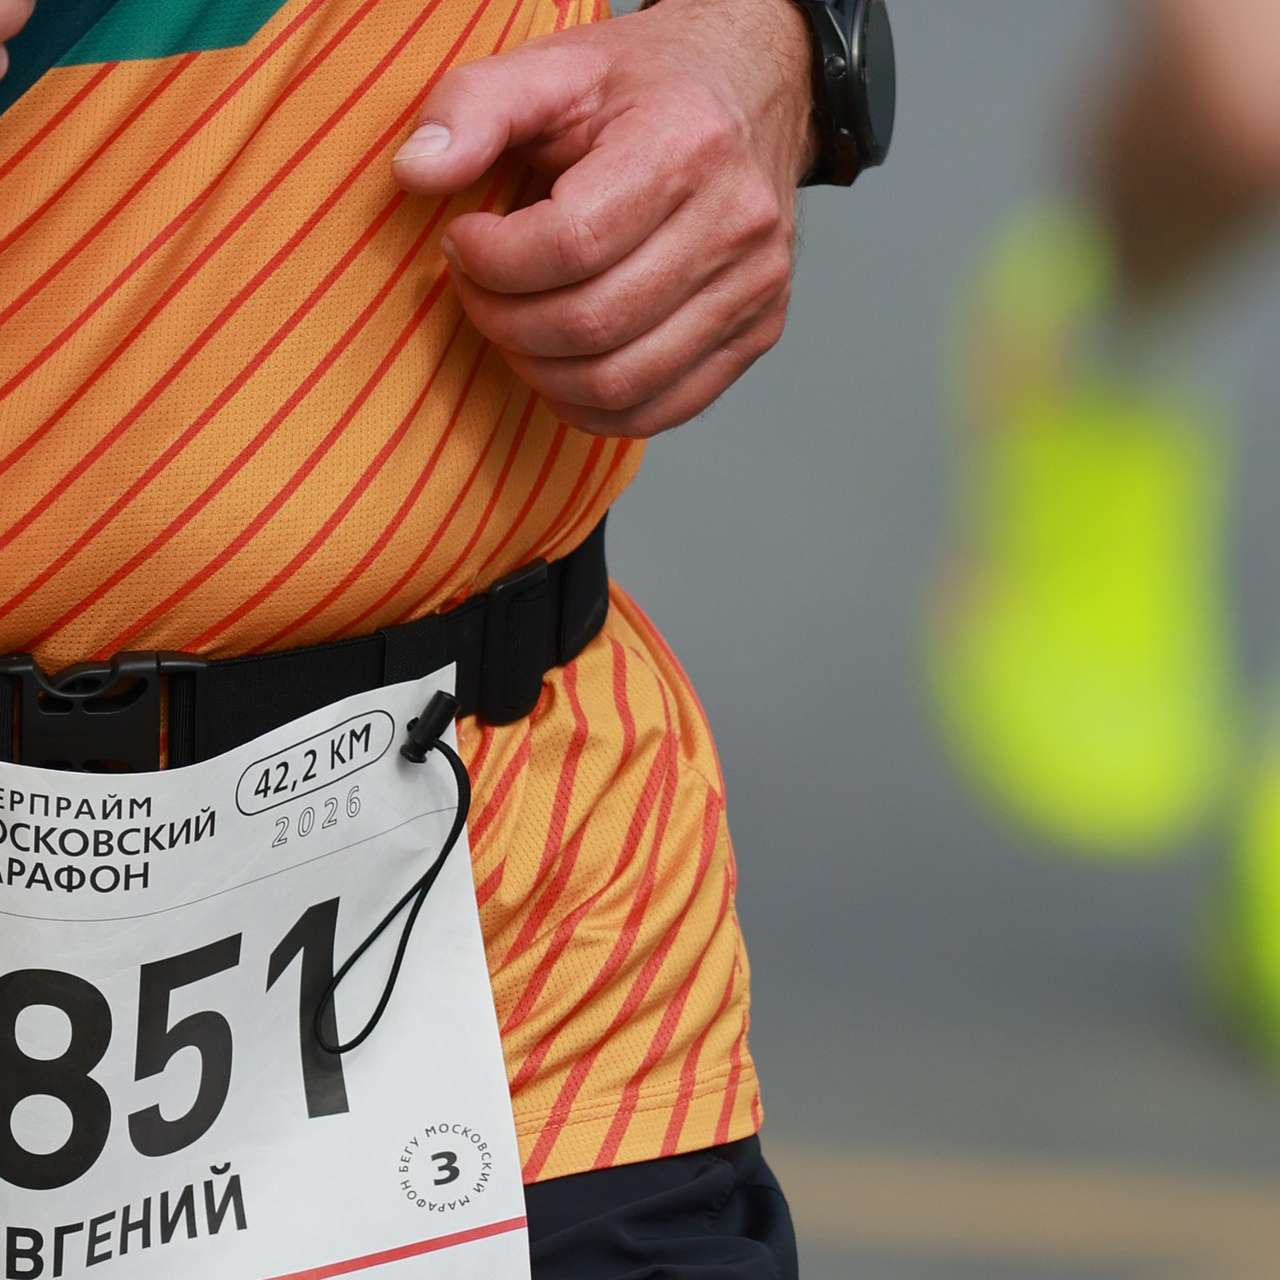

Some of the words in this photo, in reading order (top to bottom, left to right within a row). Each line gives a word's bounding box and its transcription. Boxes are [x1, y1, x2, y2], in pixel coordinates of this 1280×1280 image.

[254, 749, 317, 798] 42,2
[330, 723, 372, 770] КМ
[272, 785, 361, 848] 2026
[399, 1137, 419, 1173] БЕГУ
[425, 1123, 492, 1193] МОСКОВСКИЙ
[431, 1151, 460, 1186] 3
[400, 1180, 470, 1212] МАРАФОН
